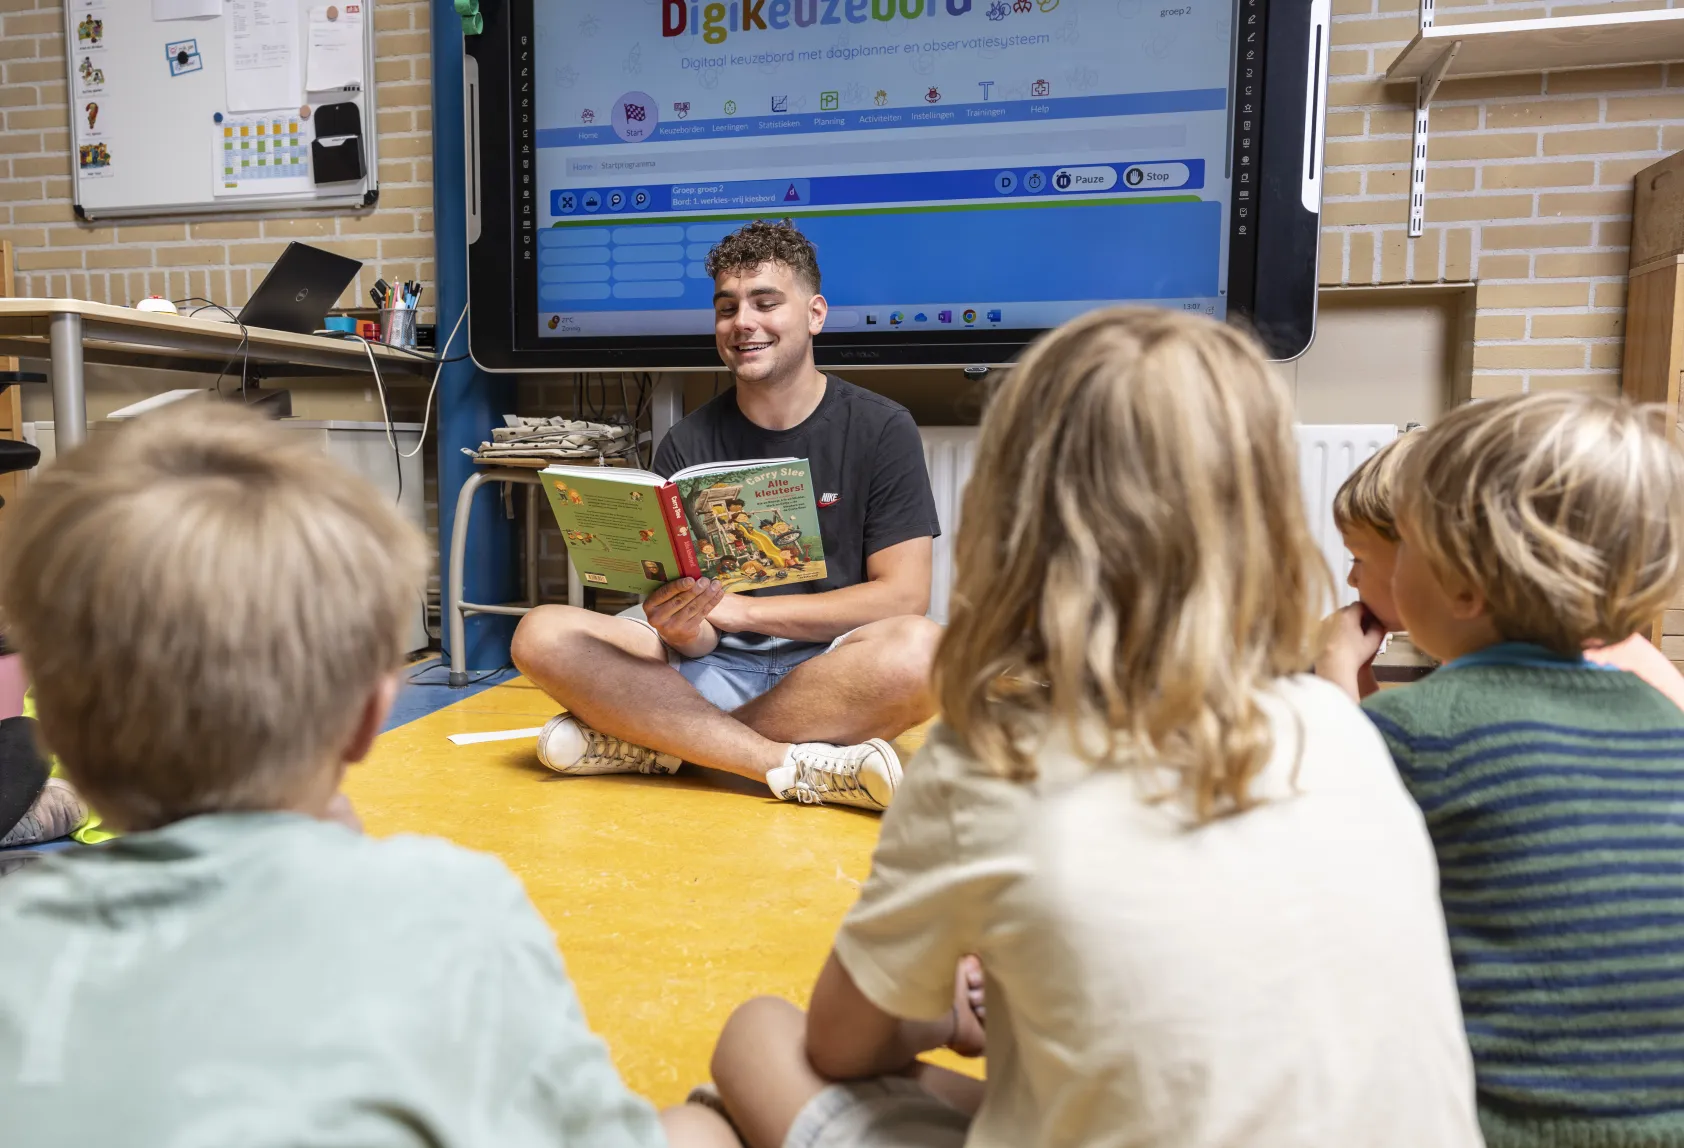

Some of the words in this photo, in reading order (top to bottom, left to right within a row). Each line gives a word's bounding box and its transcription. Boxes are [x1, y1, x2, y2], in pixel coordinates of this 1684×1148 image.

[1160, 8, 1185, 18] groep
[1185, 5, 1192, 15] 2
[681, 54, 727, 71] Digitaal
[730, 50, 794, 65] keuzebord
[798, 49, 822, 61] met
[826, 44, 900, 61] dagplanner
[903, 43, 918, 54] en
[924, 34, 1050, 52] observatiesysteem
[578, 132, 599, 140] Home
[626, 129, 643, 137] Start
[659, 125, 705, 136] Keuzeborden
[712, 123, 749, 134] Leerlingen
[758, 119, 801, 130] Statistieken
[814, 117, 846, 127] Planning
[859, 114, 902, 124] Activiteiten
[911, 110, 955, 121] Instellingen
[966, 108, 1006, 118] Trainingen
[1031, 105, 1050, 114] Help
[573, 162, 594, 171] Home
[601, 159, 656, 171] Startprogramma
[1001, 177, 1011, 188] D
[1075, 174, 1105, 185] Pauze
[1146, 171, 1169, 183] Stop
[673, 186, 697, 195] Groep:
[698, 186, 718, 195] groep
[718, 184, 724, 192] 2
[789, 187, 795, 196] d
[693, 197, 699, 205] 1.
[731, 195, 744, 205] vrij
[745, 195, 776, 203] kiesbord
[745, 471, 777, 486] Carry
[780, 467, 805, 477] Slee
[767, 479, 789, 489] Alle
[754, 483, 804, 498] kleuters!
[821, 492, 838, 502] NIKE
